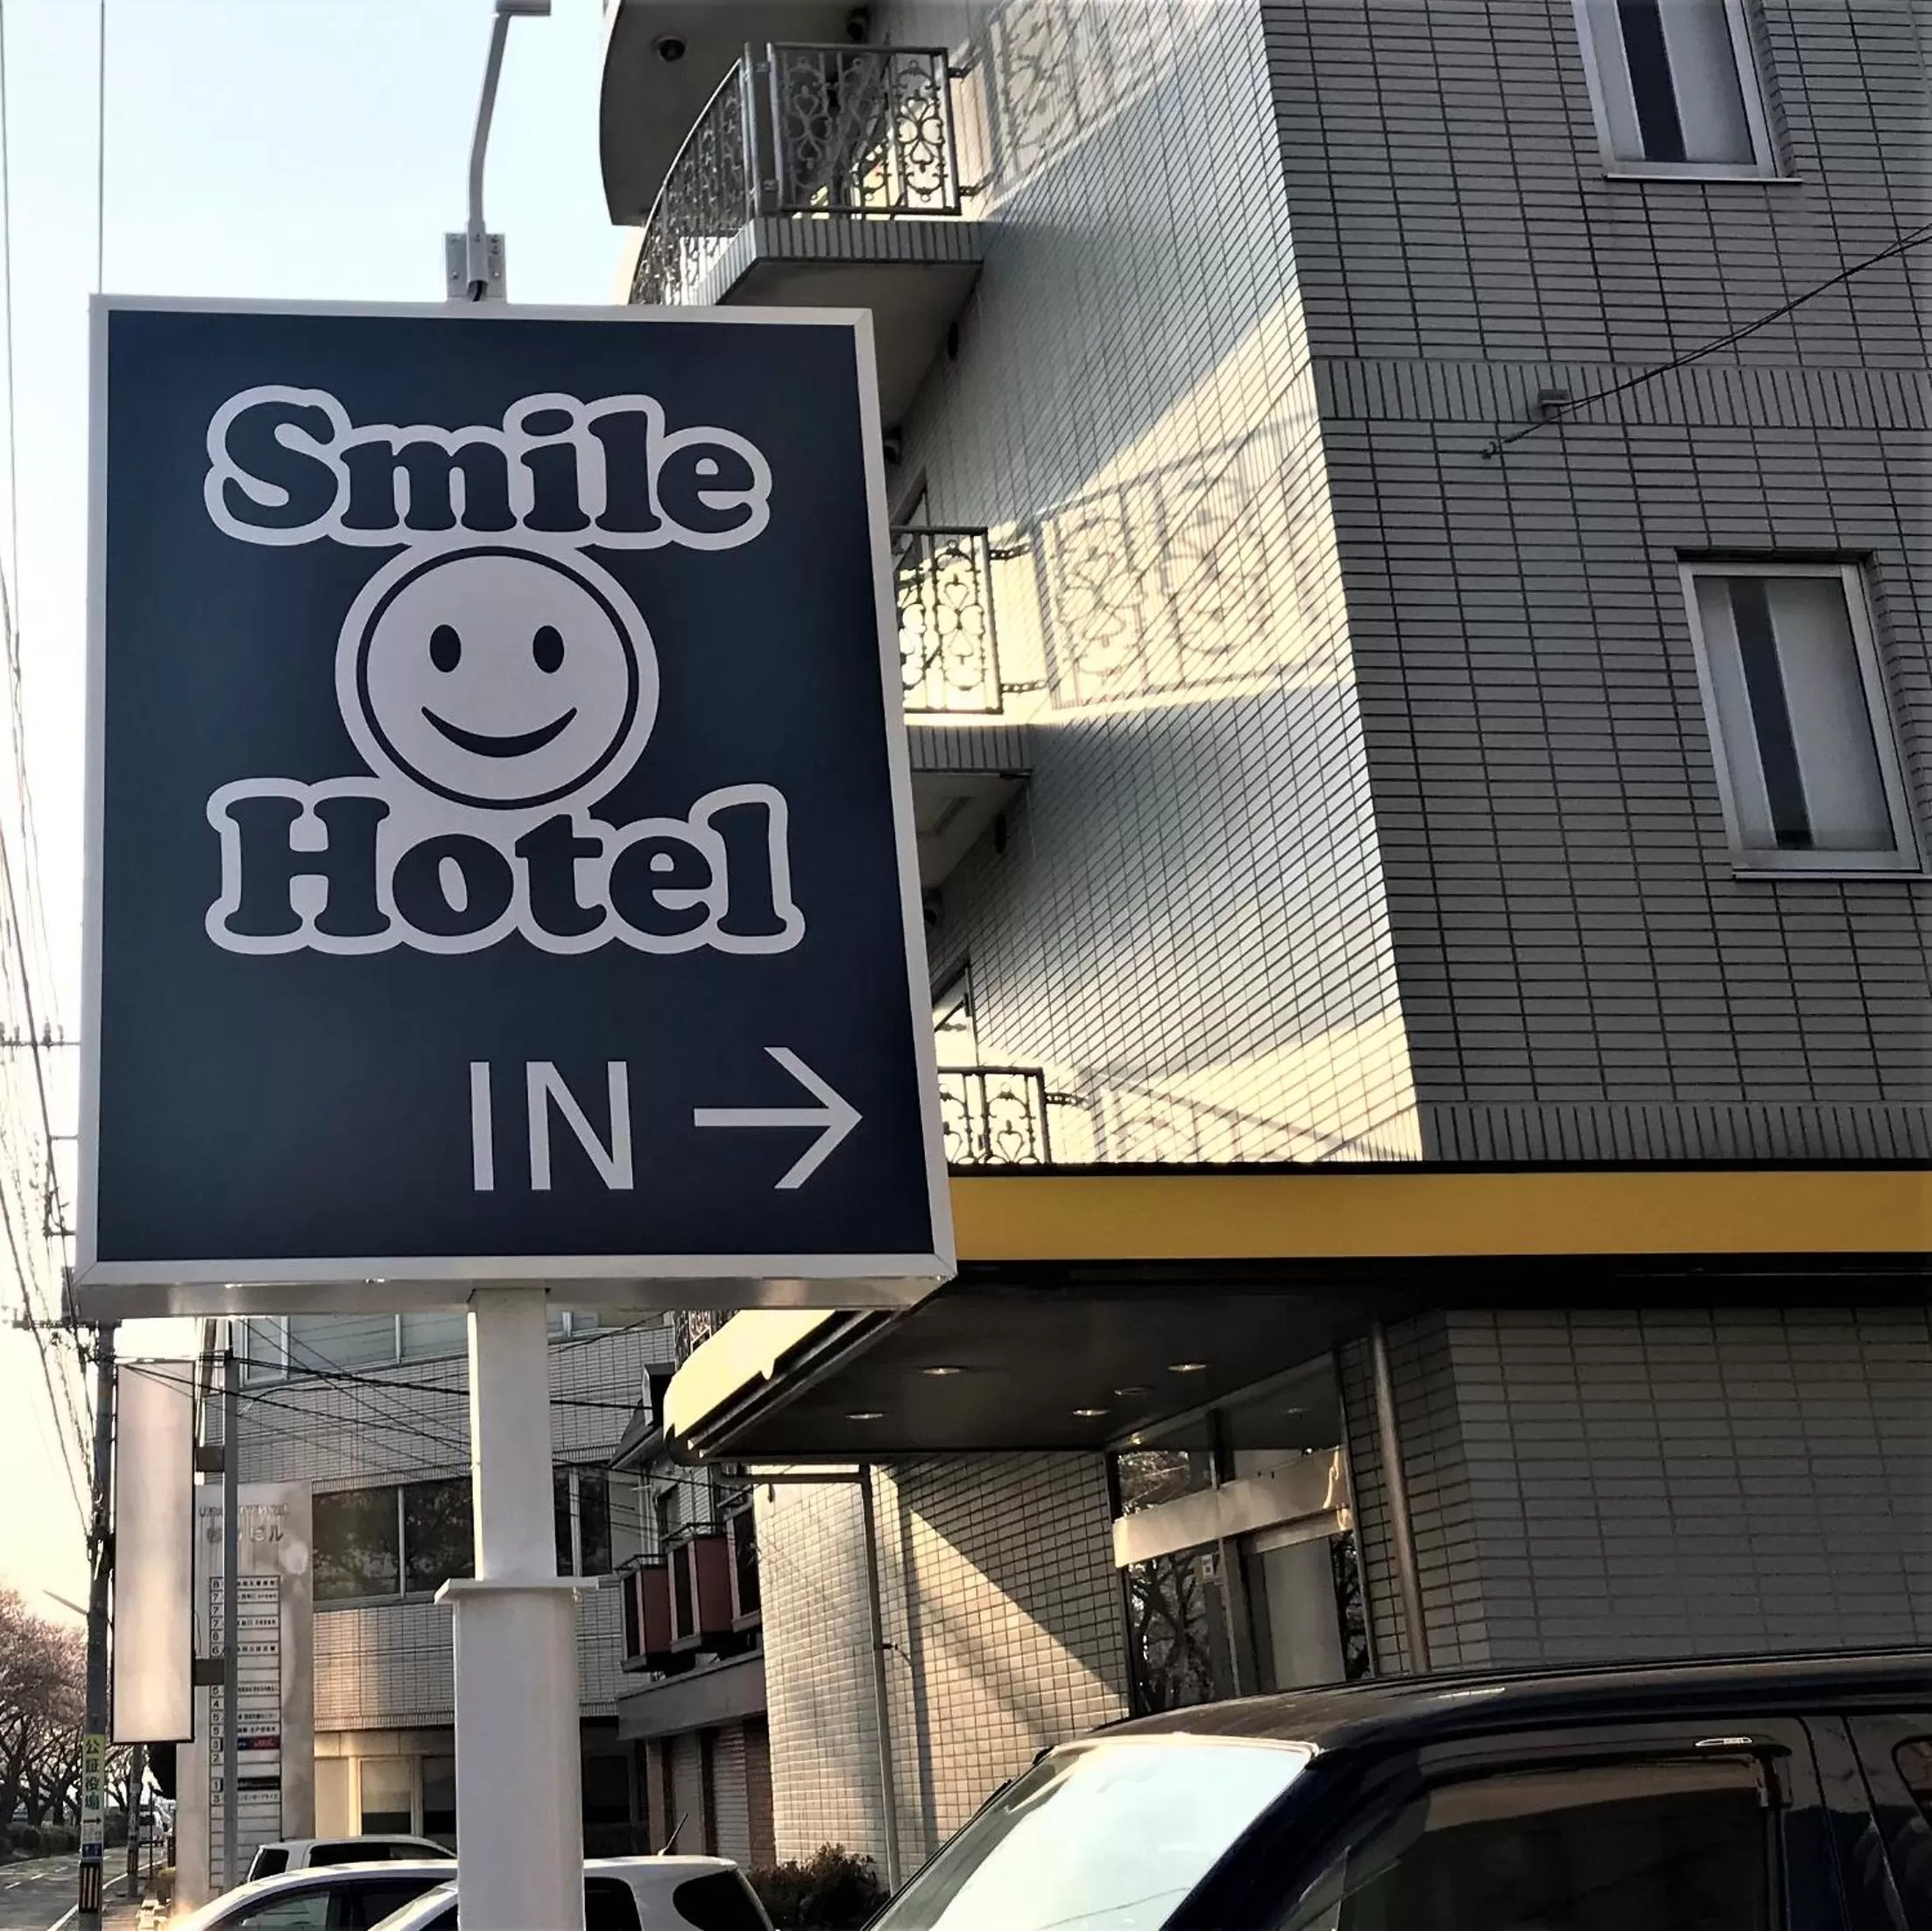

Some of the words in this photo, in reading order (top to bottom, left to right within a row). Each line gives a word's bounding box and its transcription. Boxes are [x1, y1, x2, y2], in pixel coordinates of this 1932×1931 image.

[220, 398, 758, 535] Smile
[222, 794, 790, 939] Hotel
[470, 1061, 633, 1190] IN
